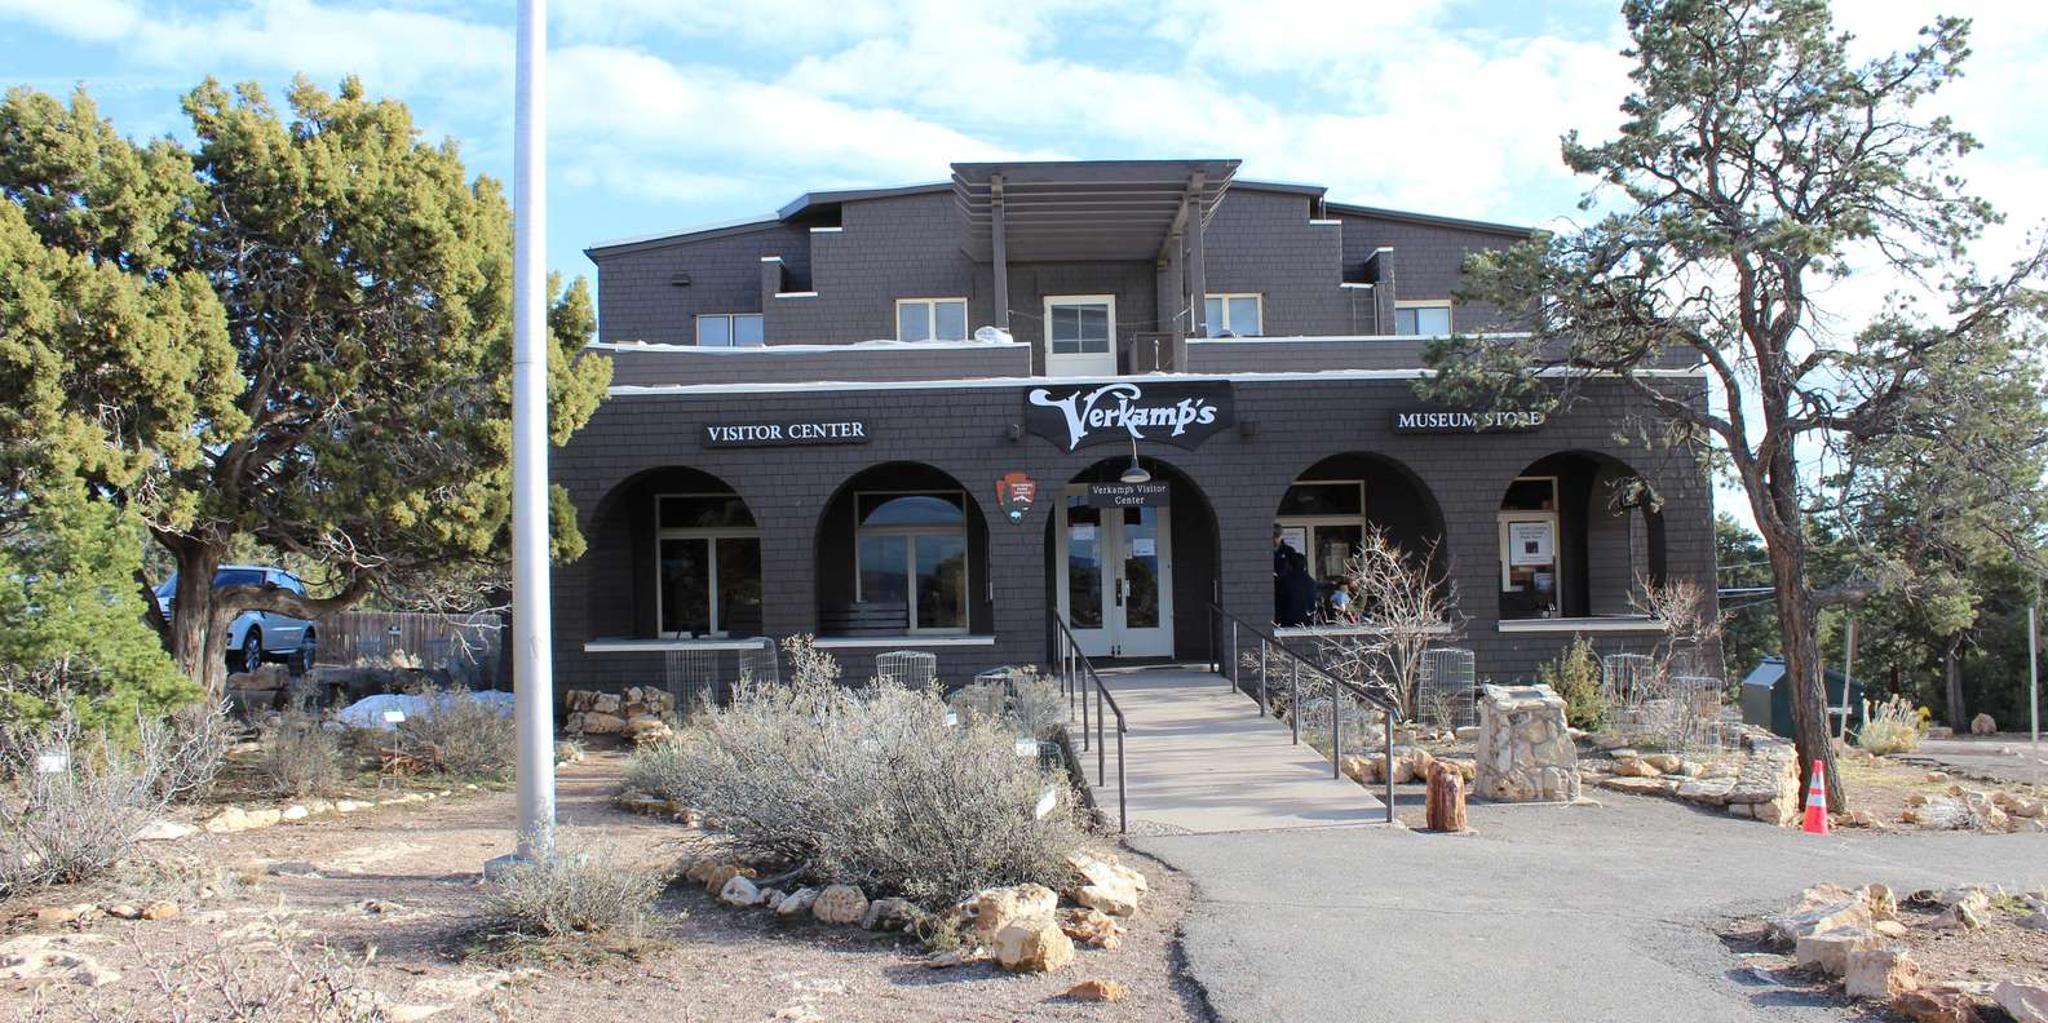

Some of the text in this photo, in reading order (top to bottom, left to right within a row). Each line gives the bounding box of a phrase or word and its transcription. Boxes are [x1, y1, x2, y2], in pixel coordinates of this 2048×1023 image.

[1029, 383, 1218, 451] Verkamp's
[1398, 412, 1478, 428] MUSEUM
[707, 422, 865, 441] VISITOR CENTER
[1136, 484, 1166, 493] Visitor
[1114, 496, 1145, 505] Center
